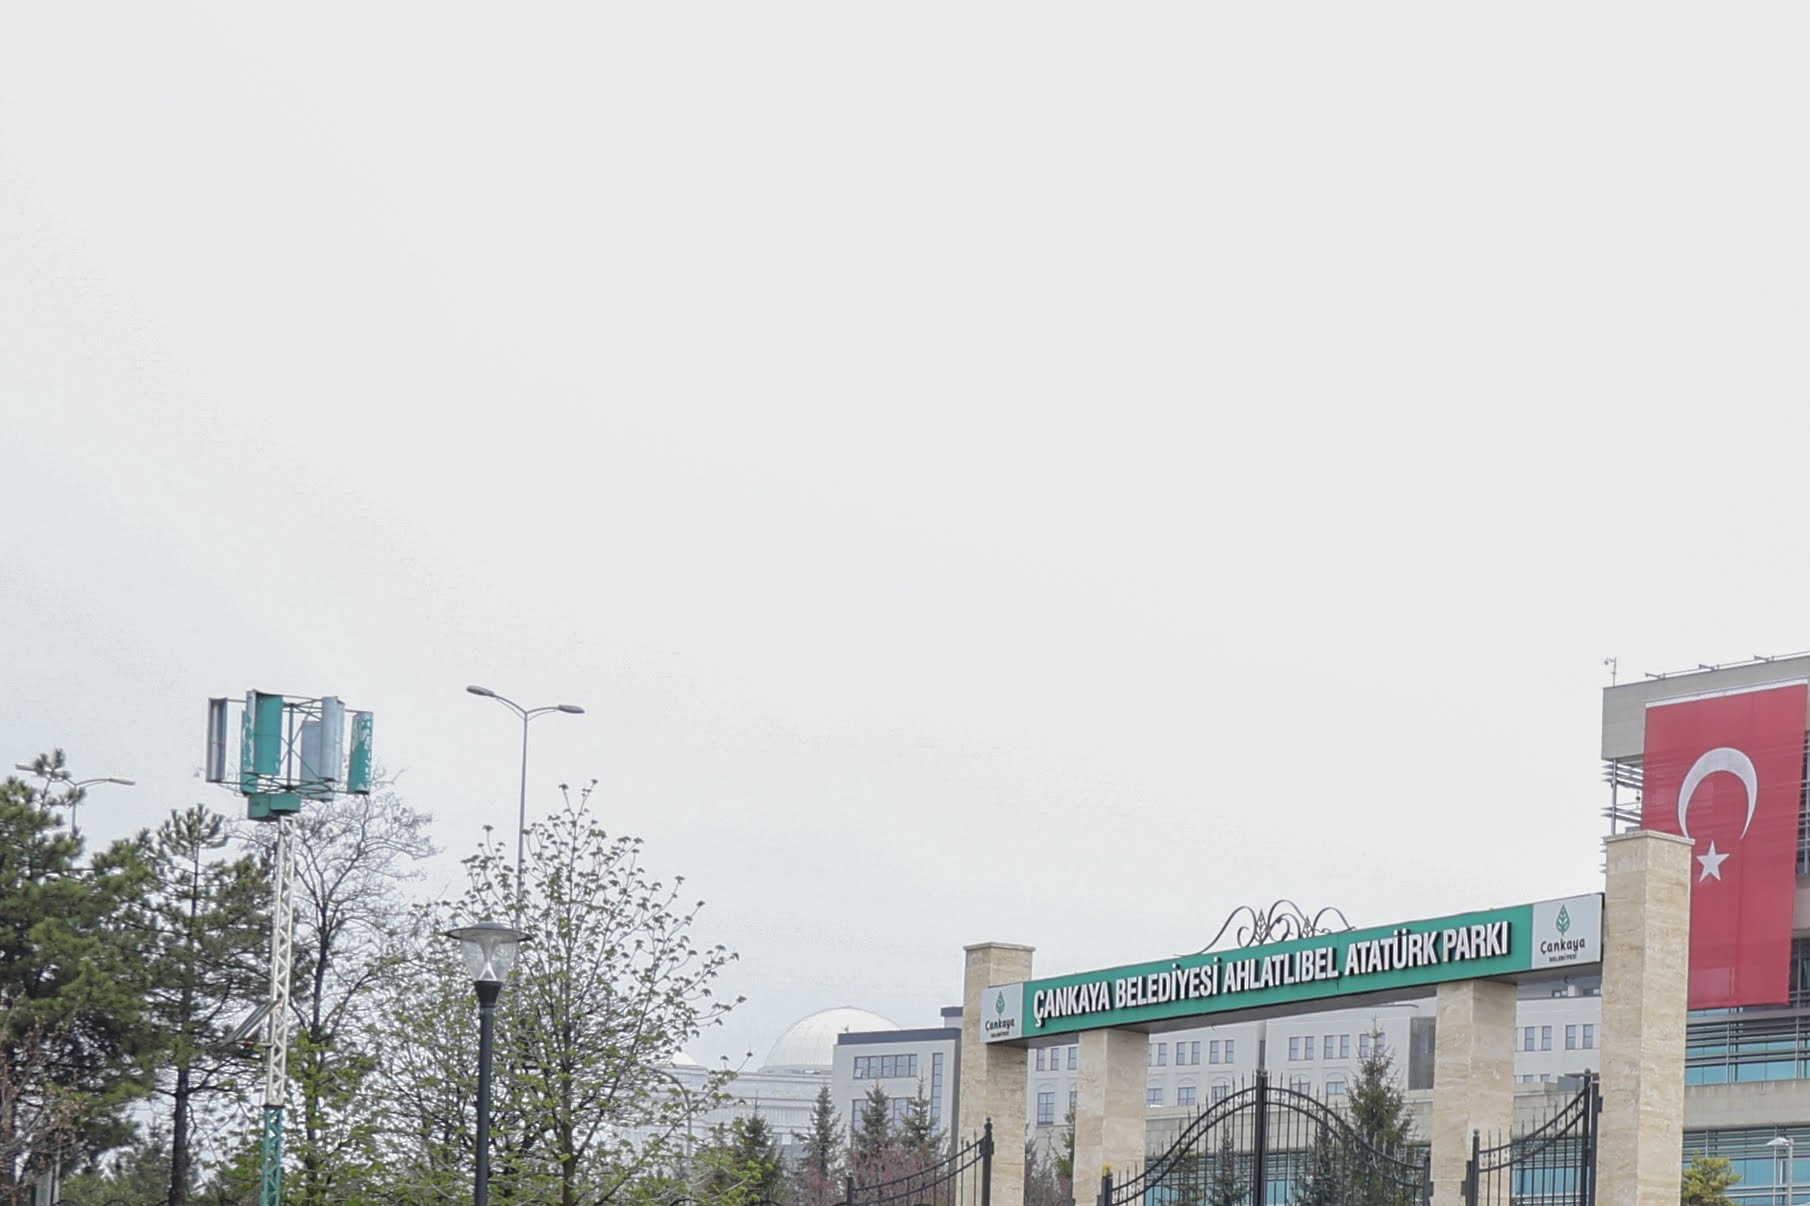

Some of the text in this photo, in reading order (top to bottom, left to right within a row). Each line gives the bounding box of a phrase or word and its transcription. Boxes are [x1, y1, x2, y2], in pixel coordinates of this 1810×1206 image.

[1033, 920, 1509, 1028] ÇANKAYA BELEDİYESİ AHLATLIBEL ATATÜRK PARKI
[1540, 938, 1585, 955] Çankaya
